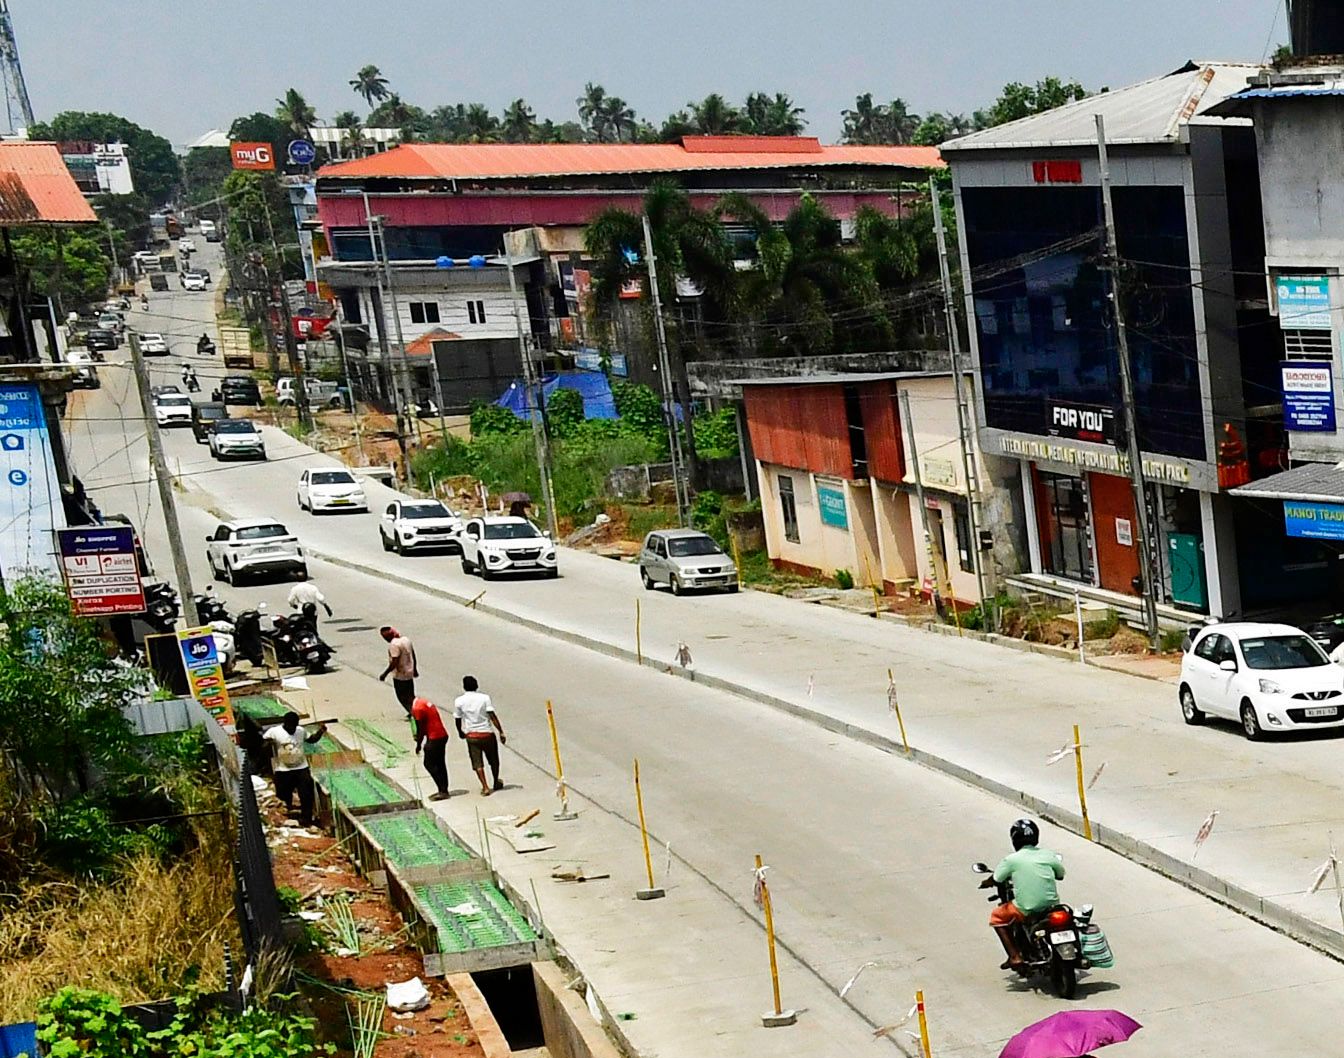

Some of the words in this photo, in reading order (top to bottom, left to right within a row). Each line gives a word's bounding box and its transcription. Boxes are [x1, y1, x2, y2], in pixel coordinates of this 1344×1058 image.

[1053, 407, 1077, 428] FOR
[1078, 411, 1103, 432] YOU
[192, 643, 209, 655] Jio
